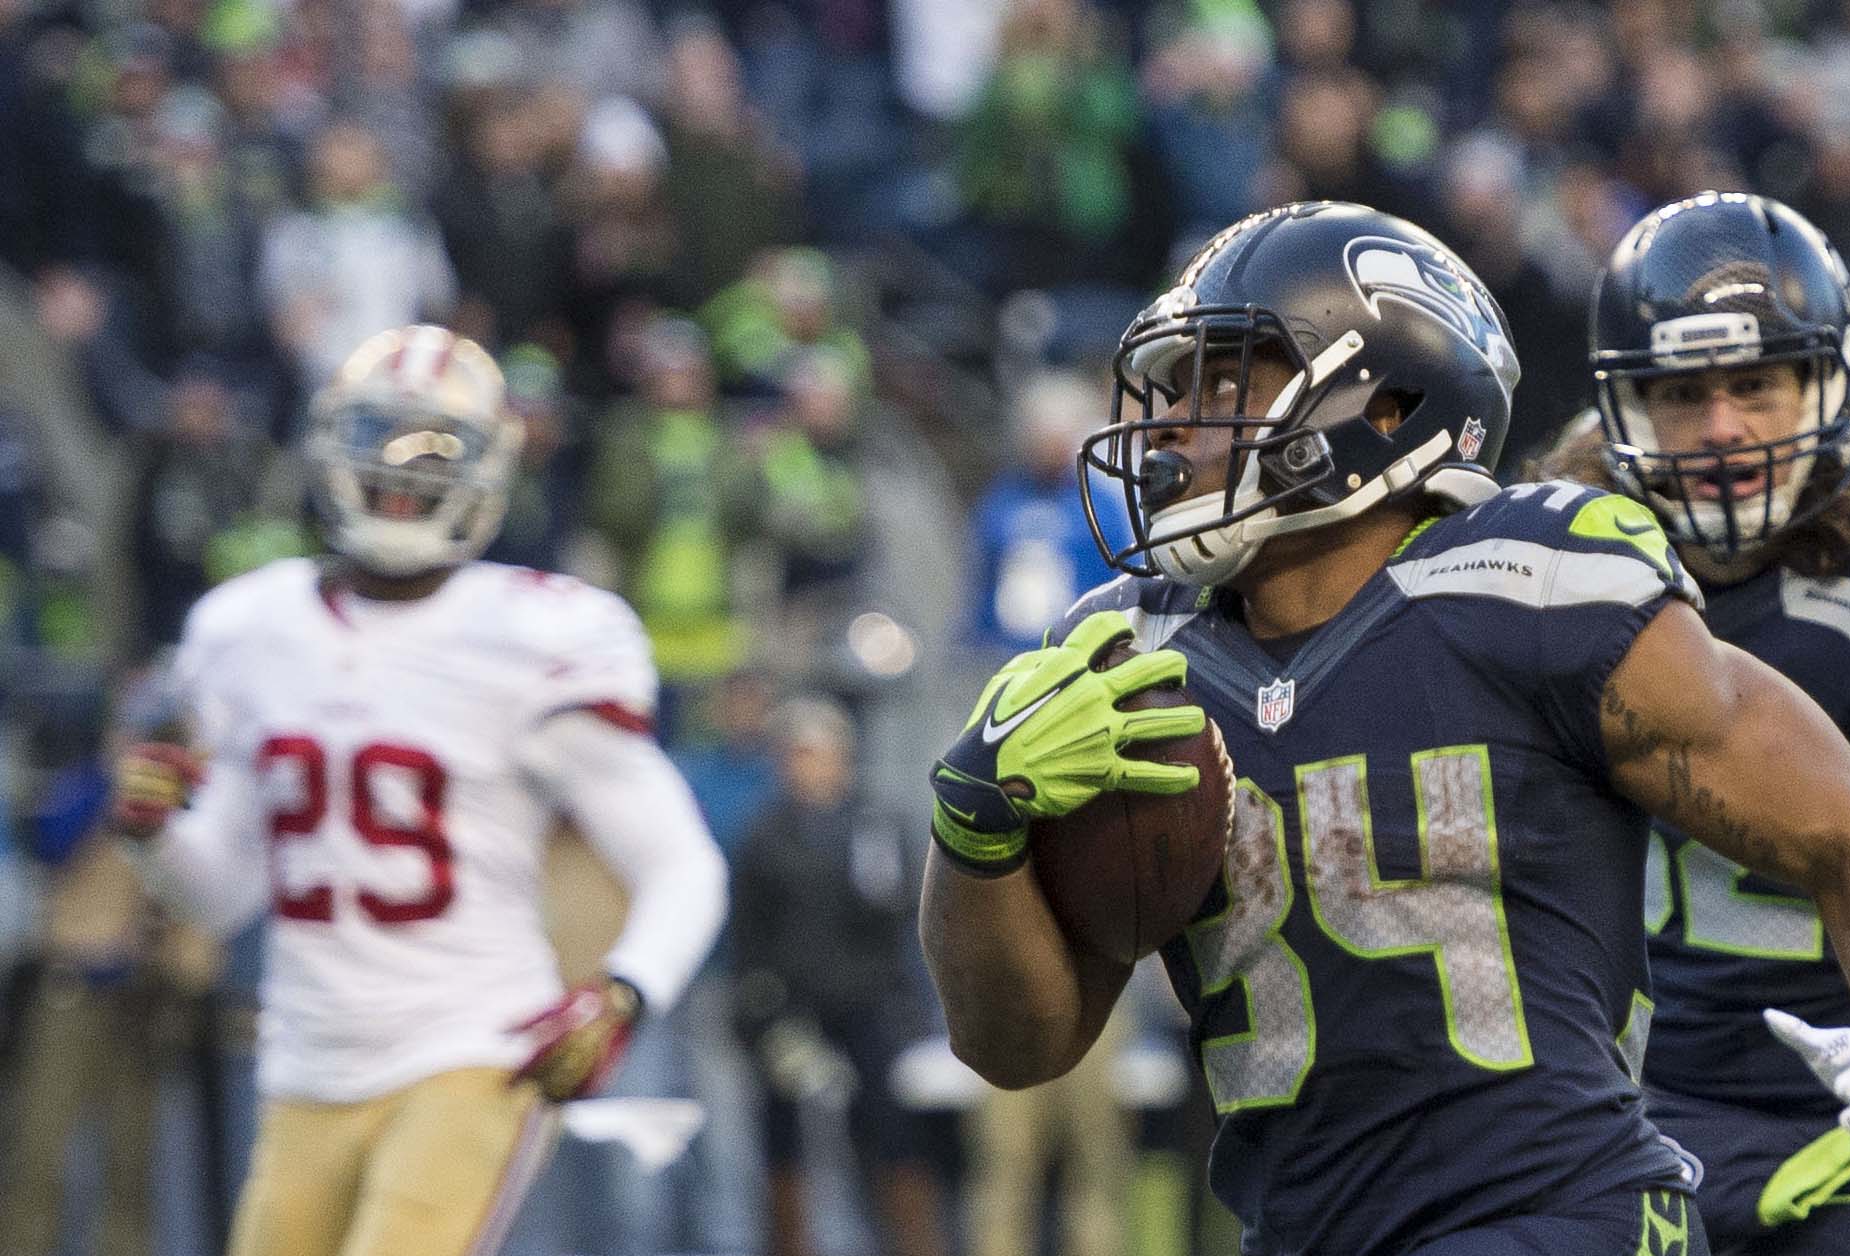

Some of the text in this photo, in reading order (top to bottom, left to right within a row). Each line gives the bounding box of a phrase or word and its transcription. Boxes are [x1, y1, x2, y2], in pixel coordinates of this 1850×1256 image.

[1428, 559, 1533, 577] SEAHAWKS
[255, 733, 456, 924] 29
[1186, 743, 1535, 1114] 34
